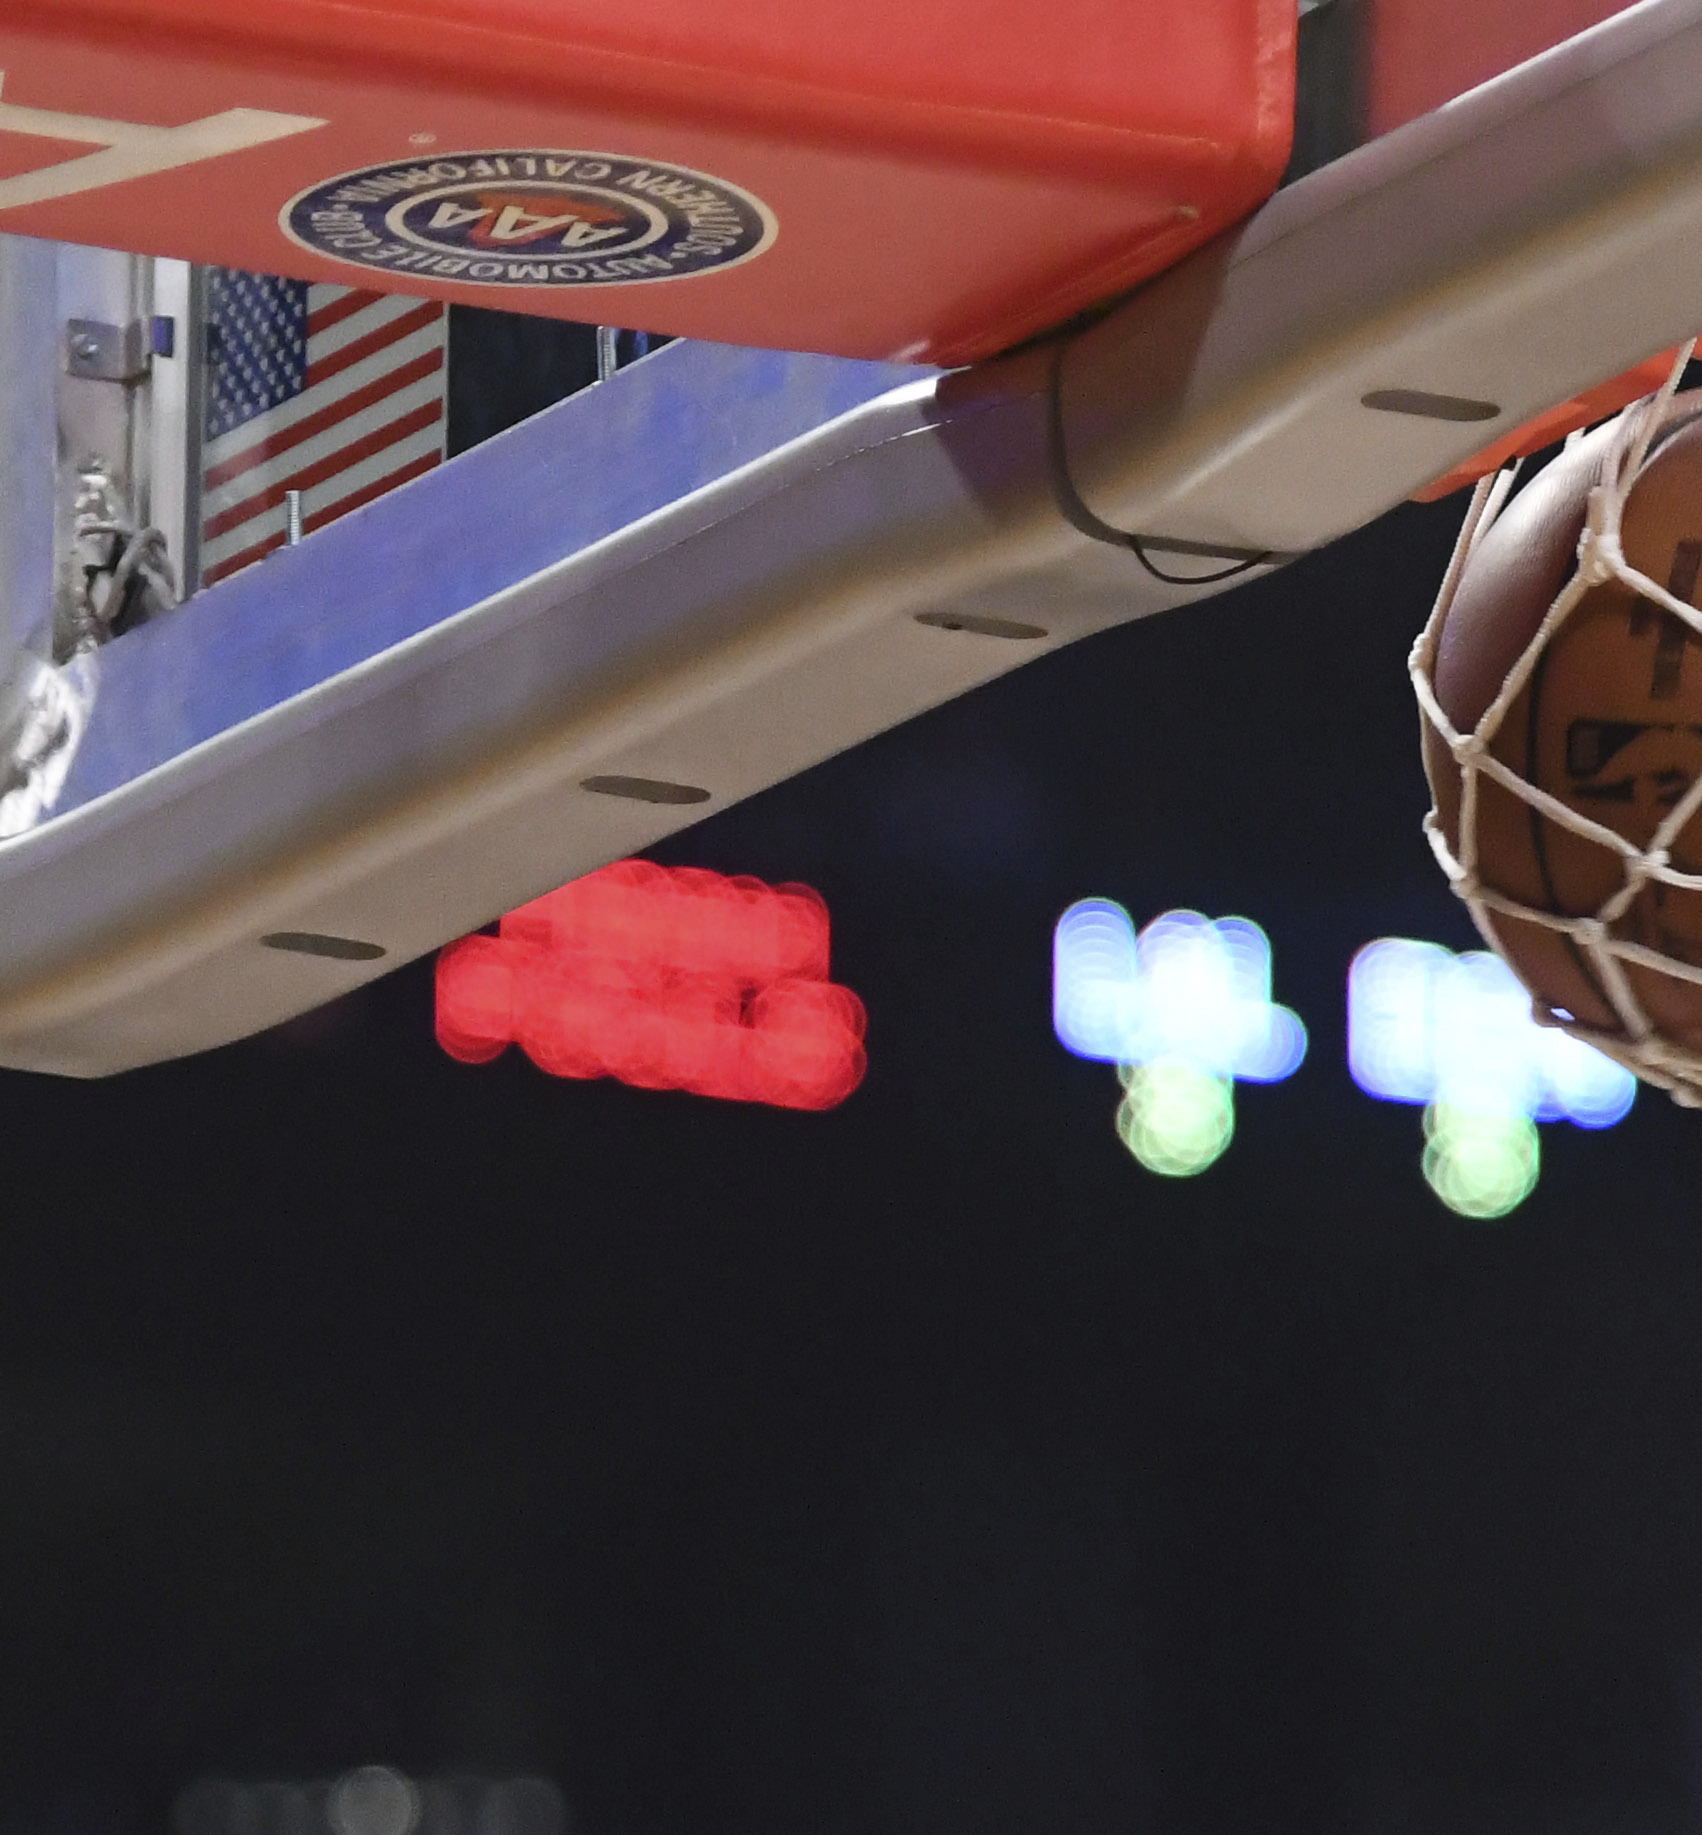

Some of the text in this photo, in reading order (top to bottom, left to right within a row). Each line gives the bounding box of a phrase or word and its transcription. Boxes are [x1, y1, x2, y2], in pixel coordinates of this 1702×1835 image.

[325, 158, 743, 256] SOUTHERN CALIFORNIA
[428, 203, 629, 247] AAA
[310, 211, 674, 281] AUTOMOBILE CLUB
